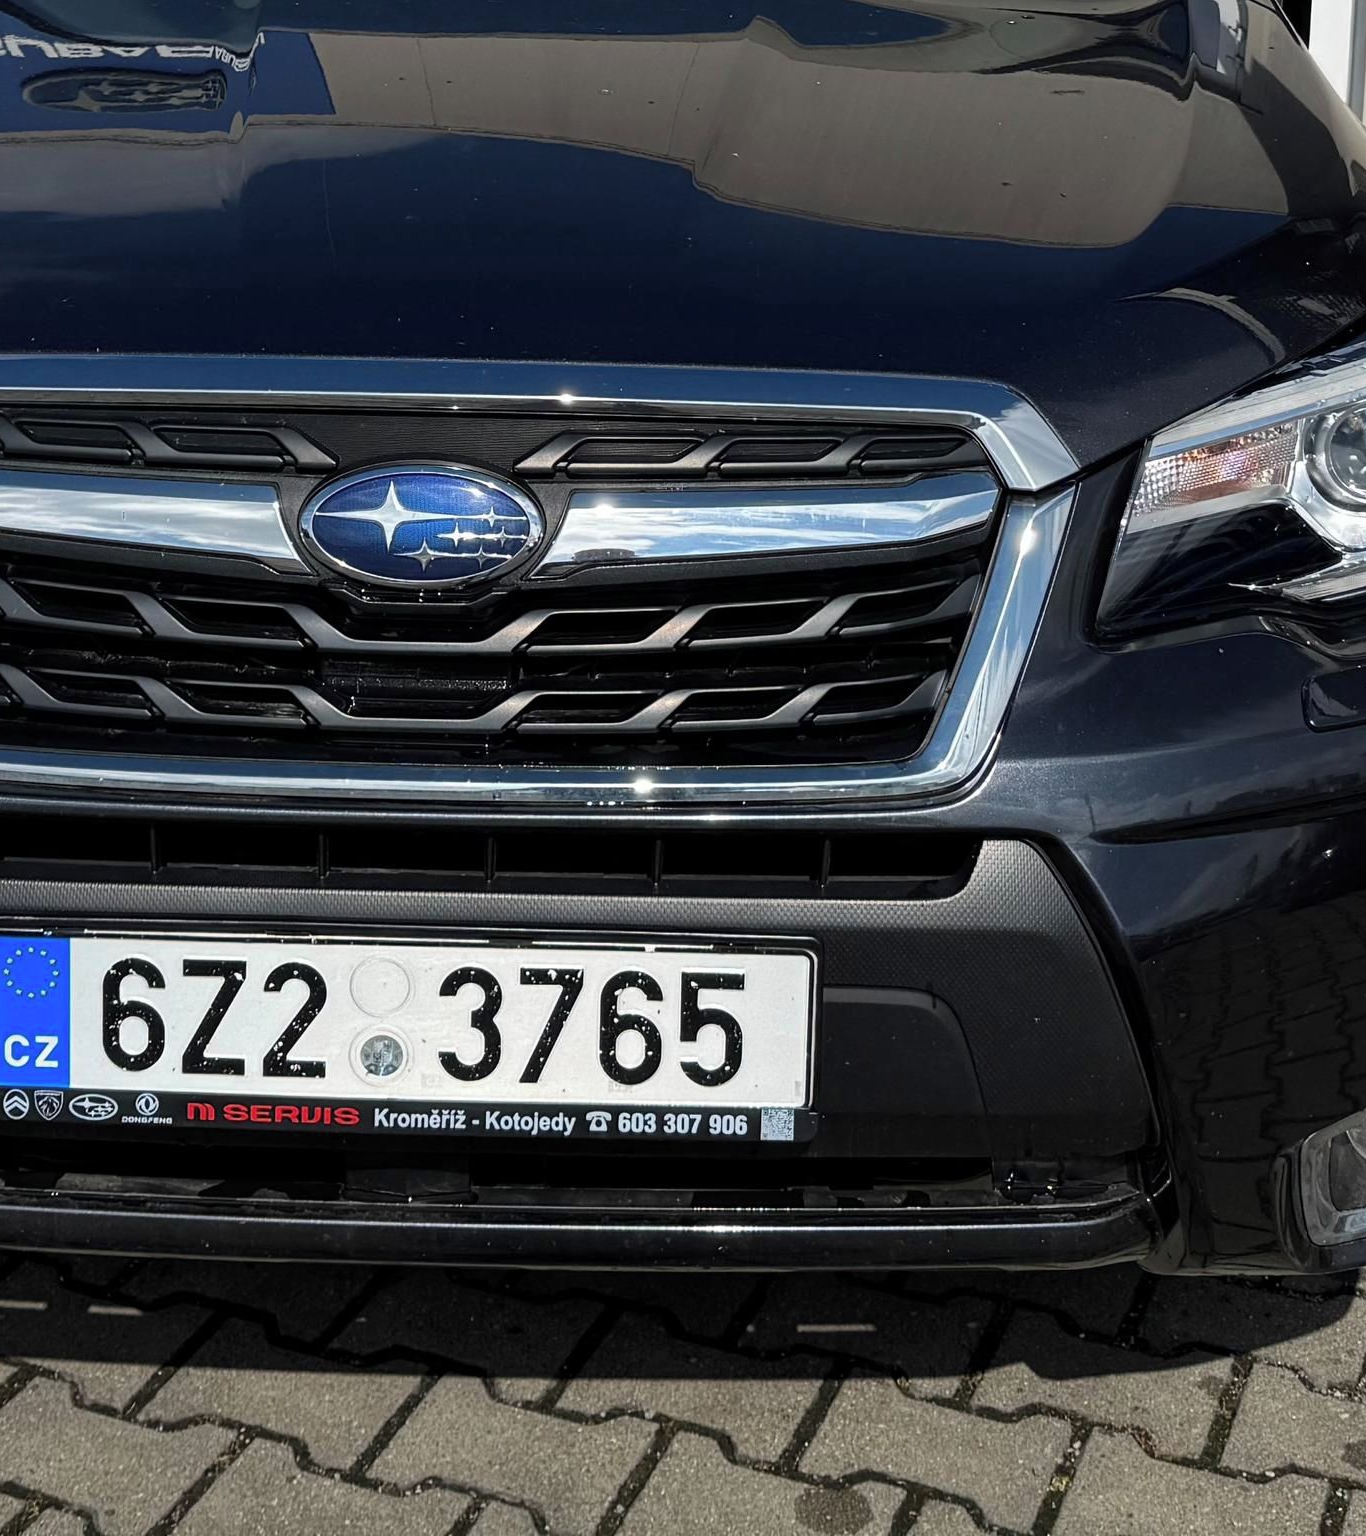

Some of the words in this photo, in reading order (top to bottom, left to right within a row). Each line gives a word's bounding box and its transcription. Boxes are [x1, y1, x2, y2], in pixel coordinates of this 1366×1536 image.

[102, 957, 327, 1078] 6Z2
[438, 966, 745, 1087] 3765
[4, 1034, 59, 1068] CZ
[121, 1116, 173, 1125] DONGFENG
[223, 1103, 361, 1125] SERVIS
[374, 1108, 466, 1129] Kroměříž
[485, 1110, 576, 1136] Kotojedy
[618, 1112, 656, 1133] 603
[663, 1113, 702, 1134] 307
[709, 1114, 748, 1135] 906
